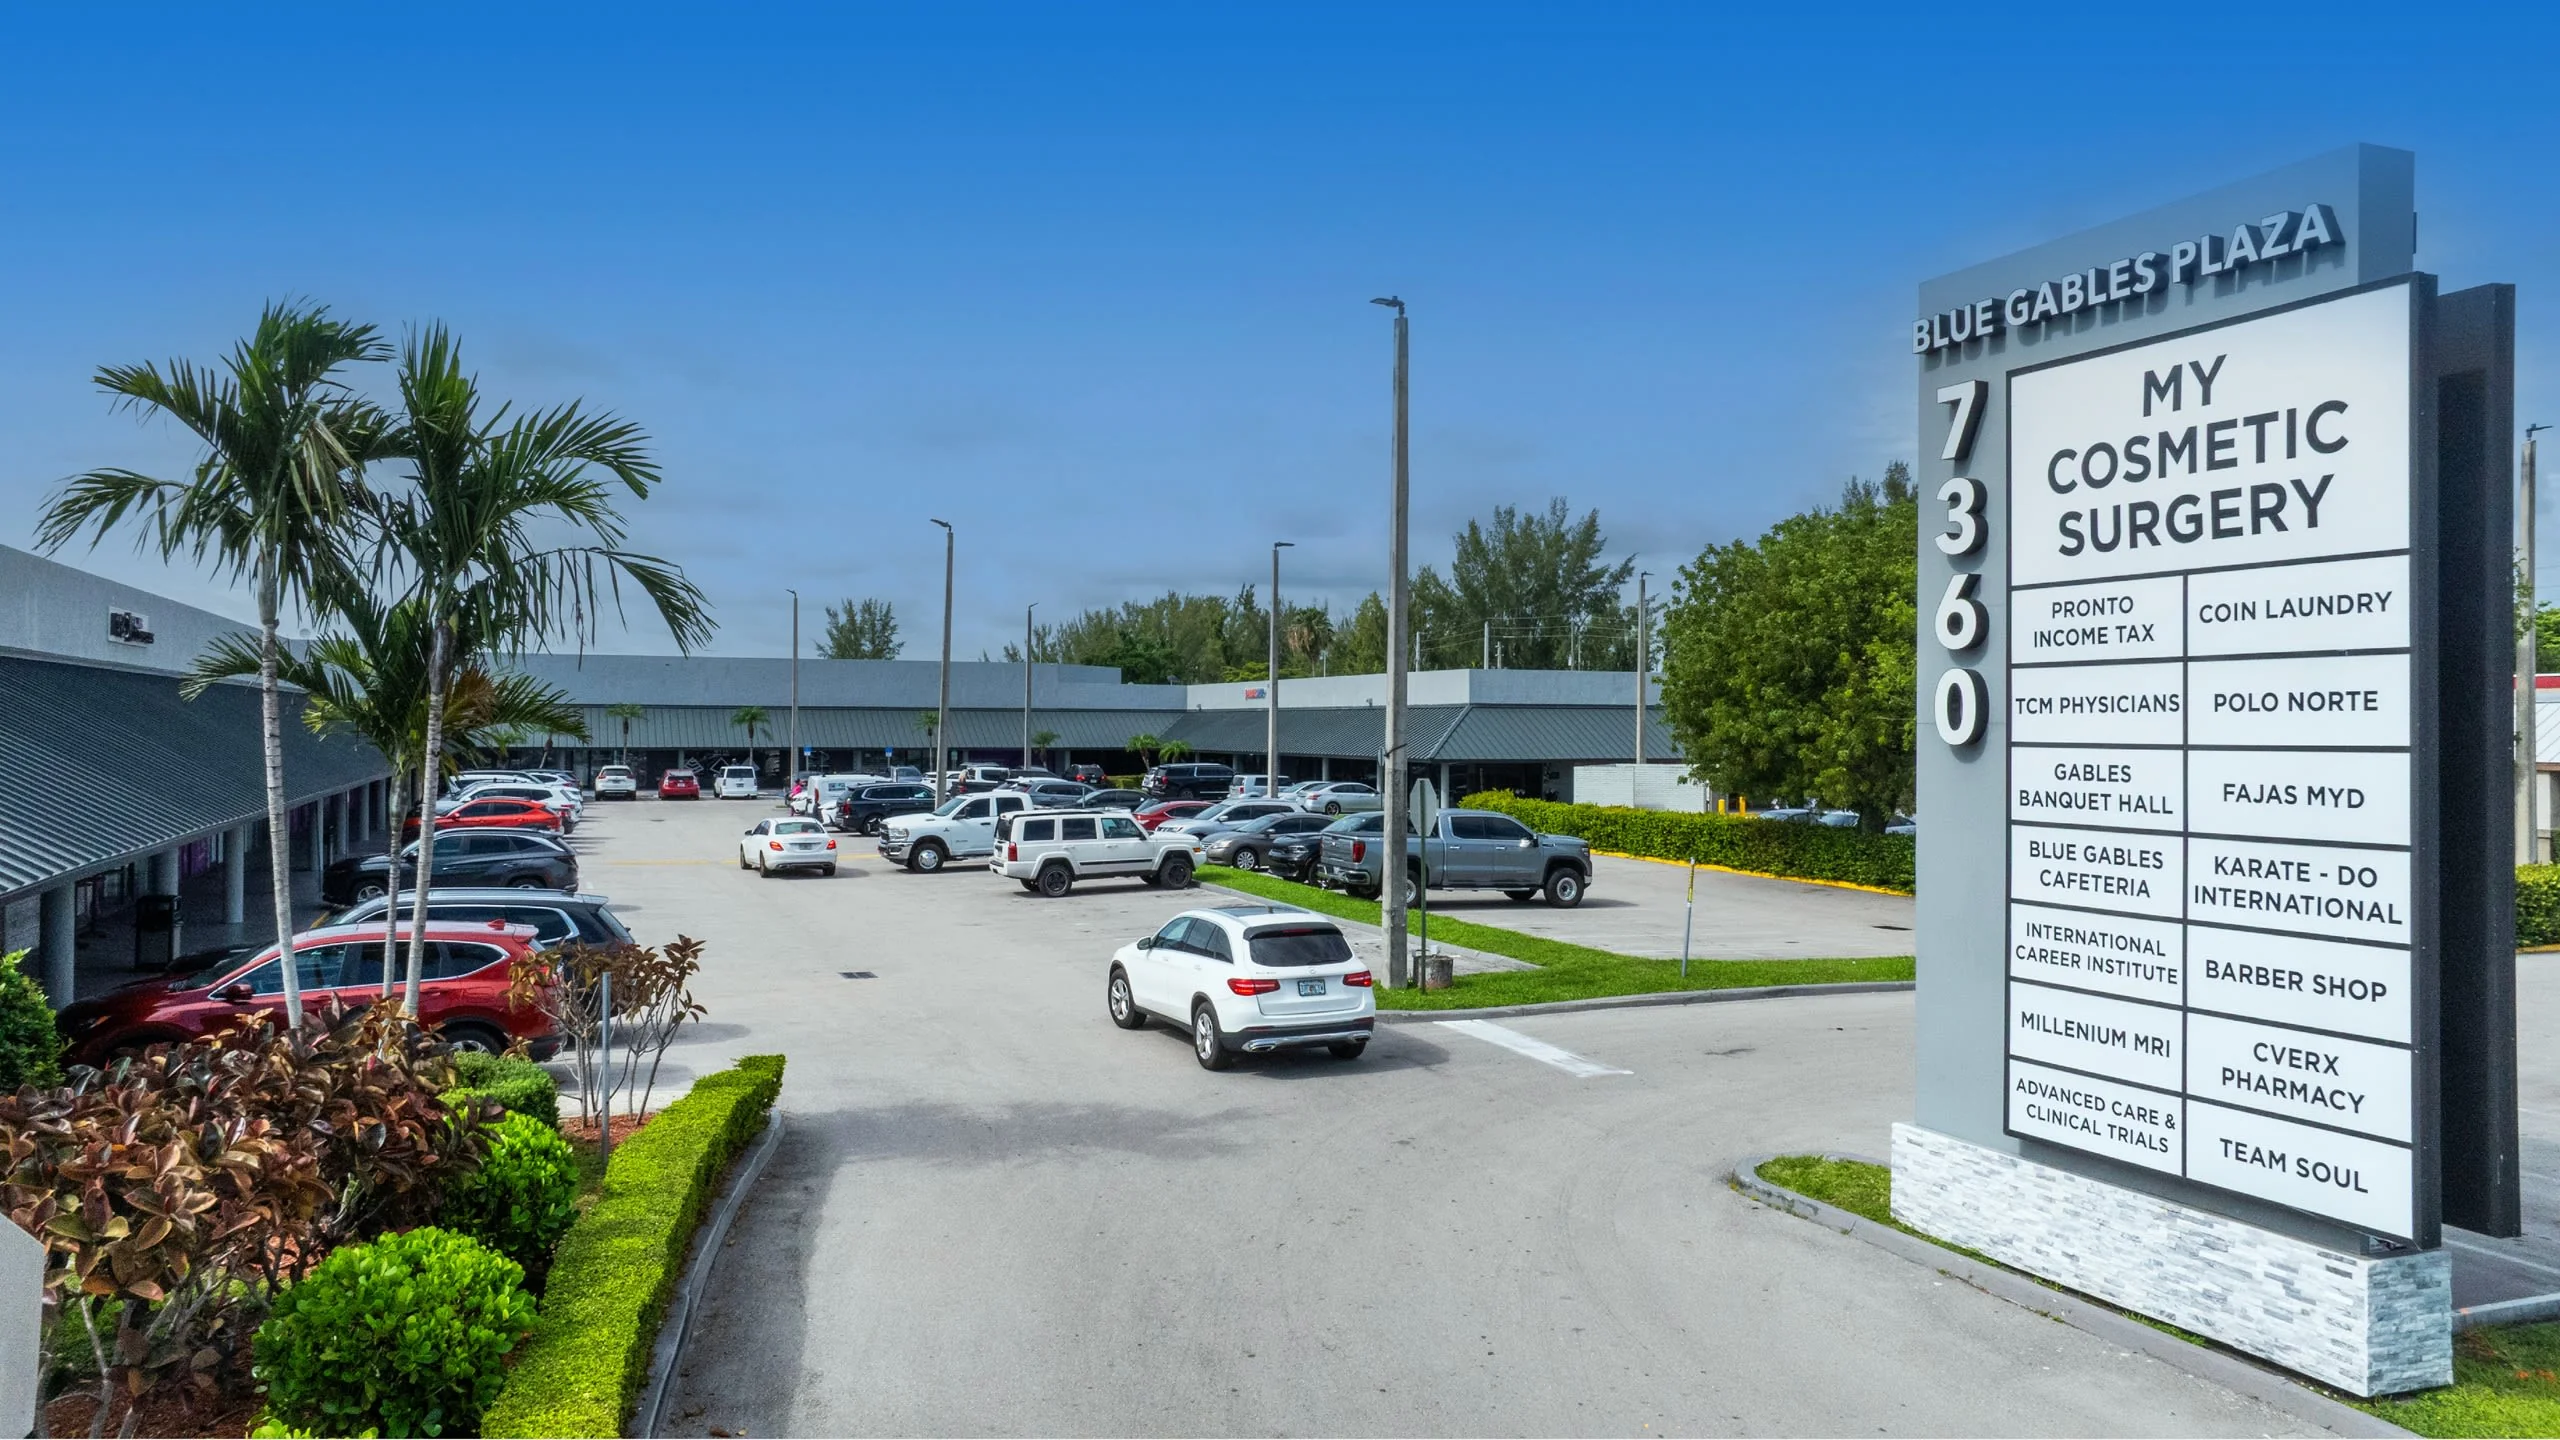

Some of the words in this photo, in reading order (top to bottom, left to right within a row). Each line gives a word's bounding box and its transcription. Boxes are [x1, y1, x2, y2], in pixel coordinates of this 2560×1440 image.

[1912, 299, 1996, 354] BLUE
[2004, 252, 2158, 328] GABLES
[2171, 203, 2335, 284] PLAZA
[2143, 354, 2227, 417] MY
[2048, 400, 2349, 494] COSMETIC
[2059, 474, 2334, 556] SURGERY
[2052, 596, 2133, 618] PRONTO
[2200, 601, 2256, 623] COIN
[2266, 591, 2392, 619] LAUNDRY
[2035, 627, 2108, 648] INCOME
[2116, 624, 2154, 643] TAX
[2016, 698, 2052, 714] TCM
[2060, 694, 2179, 713] PHYSICIANS
[2215, 693, 2278, 712] POLO
[2289, 691, 2378, 711] NORTE
[2055, 764, 2131, 783] GABLES
[2020, 790, 2111, 811] BANQUET
[2120, 794, 2173, 814] HALL
[2224, 784, 2297, 804] FAJAS
[2308, 786, 2364, 808] MYD
[2030, 841, 2076, 861] BLUE
[2084, 846, 2163, 869] GABLES
[2040, 869, 2150, 898] CAFETERIA
[2215, 856, 2310, 882] KARATE
[2338, 866, 2377, 888] DO
[2195, 885, 2402, 925] INTERNATIONAL
[2027, 923, 2165, 956] INTERNATIONAL
[2016, 945, 2080, 968] CAREER
[2088, 956, 2177, 984] INSTITUTE
[2206, 960, 2303, 991] BARBER
[2313, 975, 2386, 1002] SHOP
[2022, 1011, 2125, 1048] MILLENIUM
[2135, 1034, 2169, 1057] MRI
[2254, 1043, 2339, 1076] CVERX
[2017, 1078, 2105, 1111] ADVANCED
[2112, 1101, 2158, 1125] CARE
[2165, 1114, 2175, 1129] &
[2223, 1067, 2364, 1113] PHARMACY
[2027, 1104, 2101, 1135] CLINICAL
[2108, 1124, 2168, 1153] TRIALS
[2220, 1138, 2286, 1172] TEAM
[2296, 1158, 2368, 1193] SOUL
